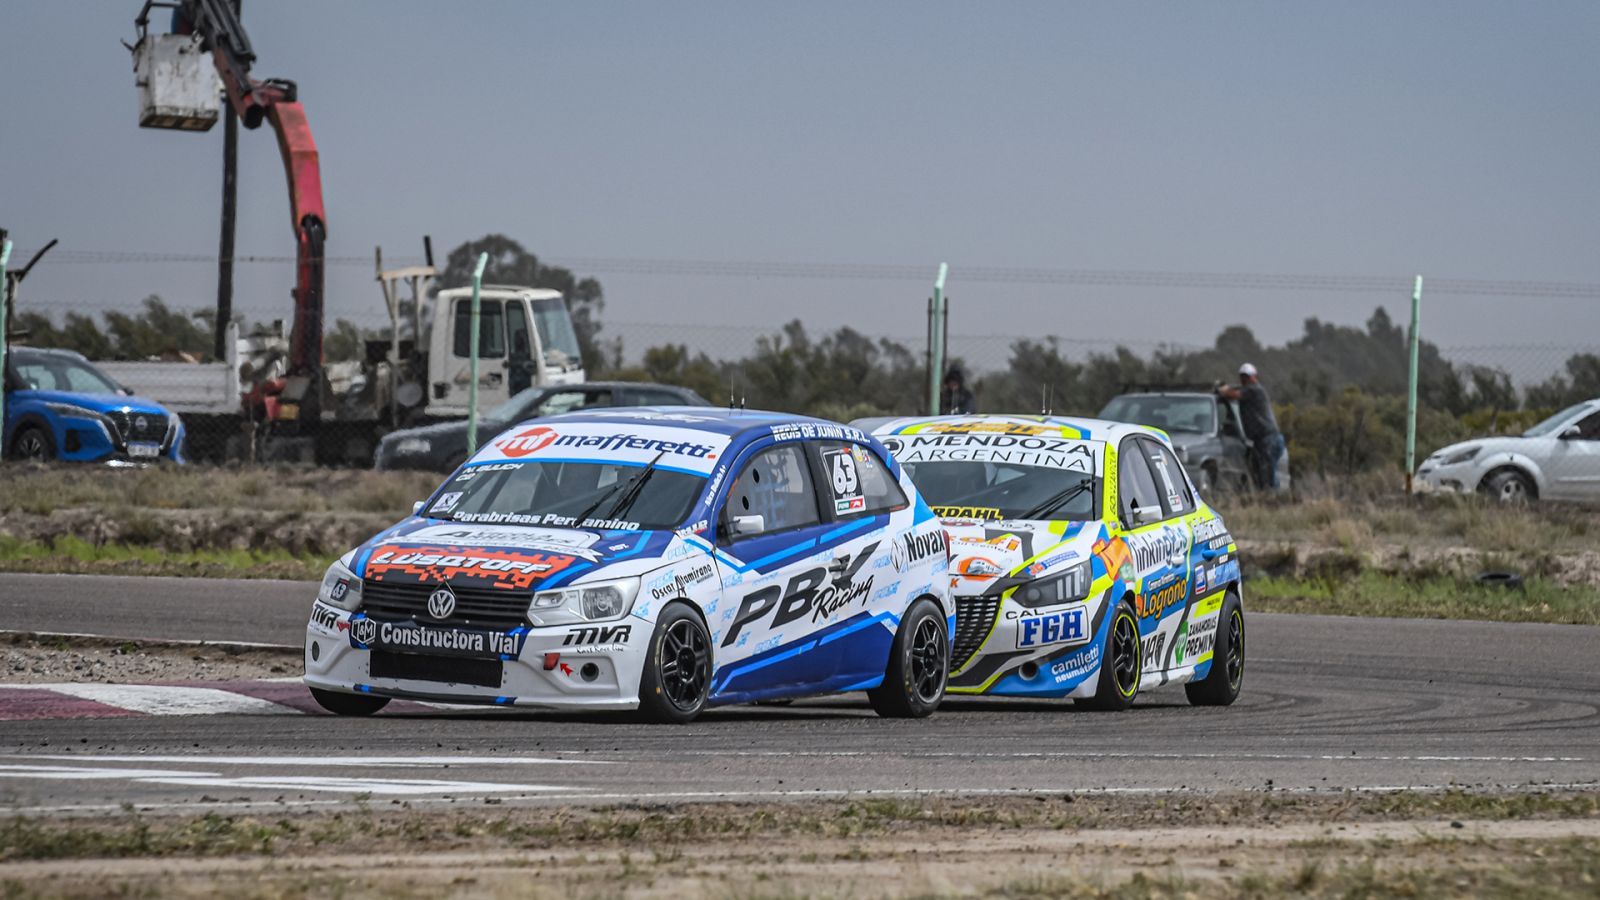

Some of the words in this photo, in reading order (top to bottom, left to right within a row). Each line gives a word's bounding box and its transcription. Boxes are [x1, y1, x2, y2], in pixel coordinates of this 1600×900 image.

[802, 427, 815, 438] DE
[555, 434, 716, 458] mafferetti
[911, 436, 1092, 457] MENDOZA
[905, 449, 1086, 471] ARGENTINA
[833, 454, 857, 494] 63
[453, 511, 541, 524] Parabrisas
[544, 514, 641, 530] Peramino
[903, 529, 945, 562] Novax
[652, 583, 676, 600] Oscar
[811, 575, 875, 624] Racing
[1005, 608, 1045, 620] CAL
[380, 623, 483, 651] Constructora
[489, 631, 519, 655] Vial
[563, 625, 631, 646] MVR
[1020, 611, 1083, 647] FGH
[1051, 643, 1099, 675] camiletti
